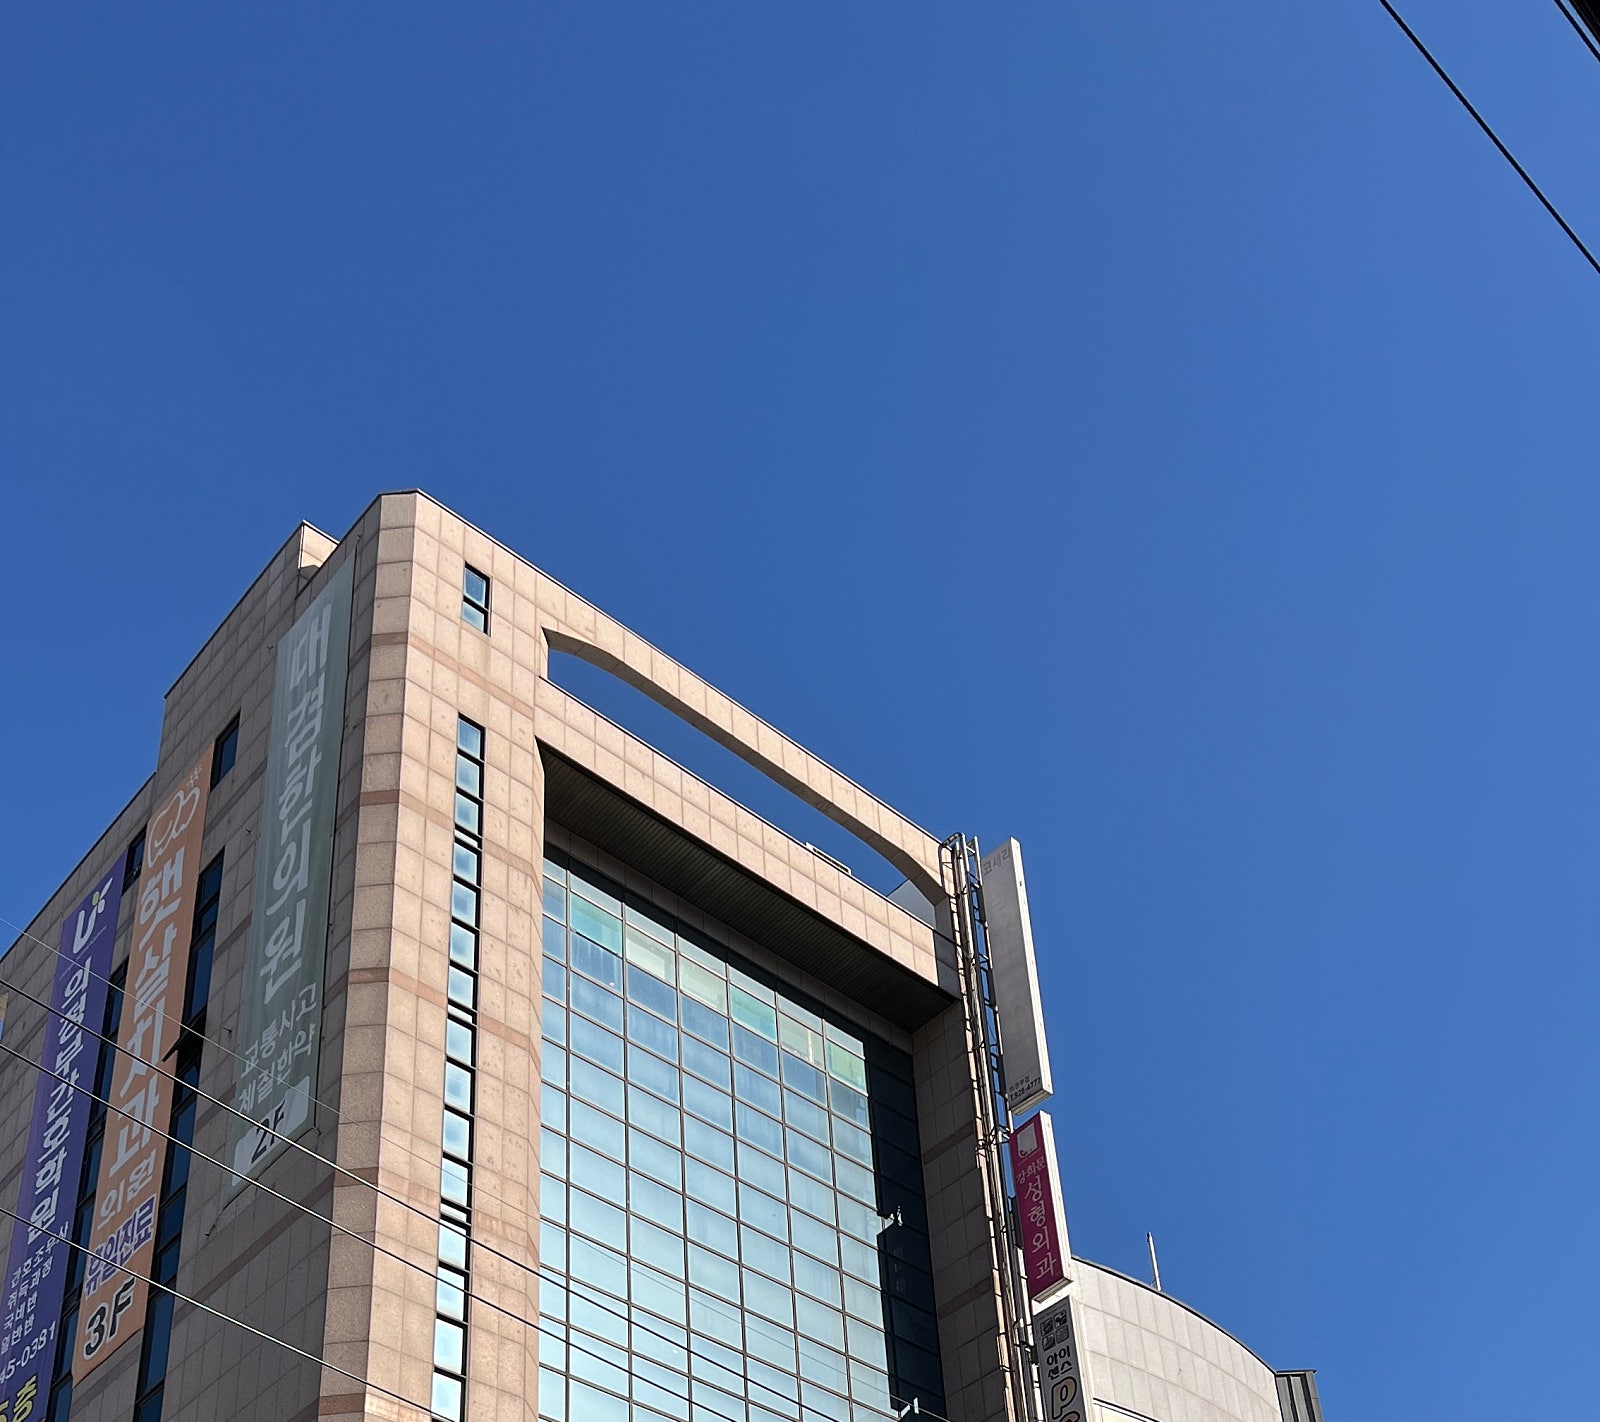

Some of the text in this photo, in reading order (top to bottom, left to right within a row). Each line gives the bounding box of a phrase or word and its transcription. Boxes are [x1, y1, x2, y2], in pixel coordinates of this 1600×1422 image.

[260, 603, 332, 1005] 대겸한의원
[109, 846, 185, 1178] 햇살치과
[241, 982, 317, 1079] 교통사고
[28, 957, 91, 1245] 의정부간호학원
[239, 1023, 316, 1115] 체질한약
[98, 1149, 156, 1230] 의원
[1025, 1177, 1057, 1280] 성형외과
[84, 1270, 137, 1361] 3F
